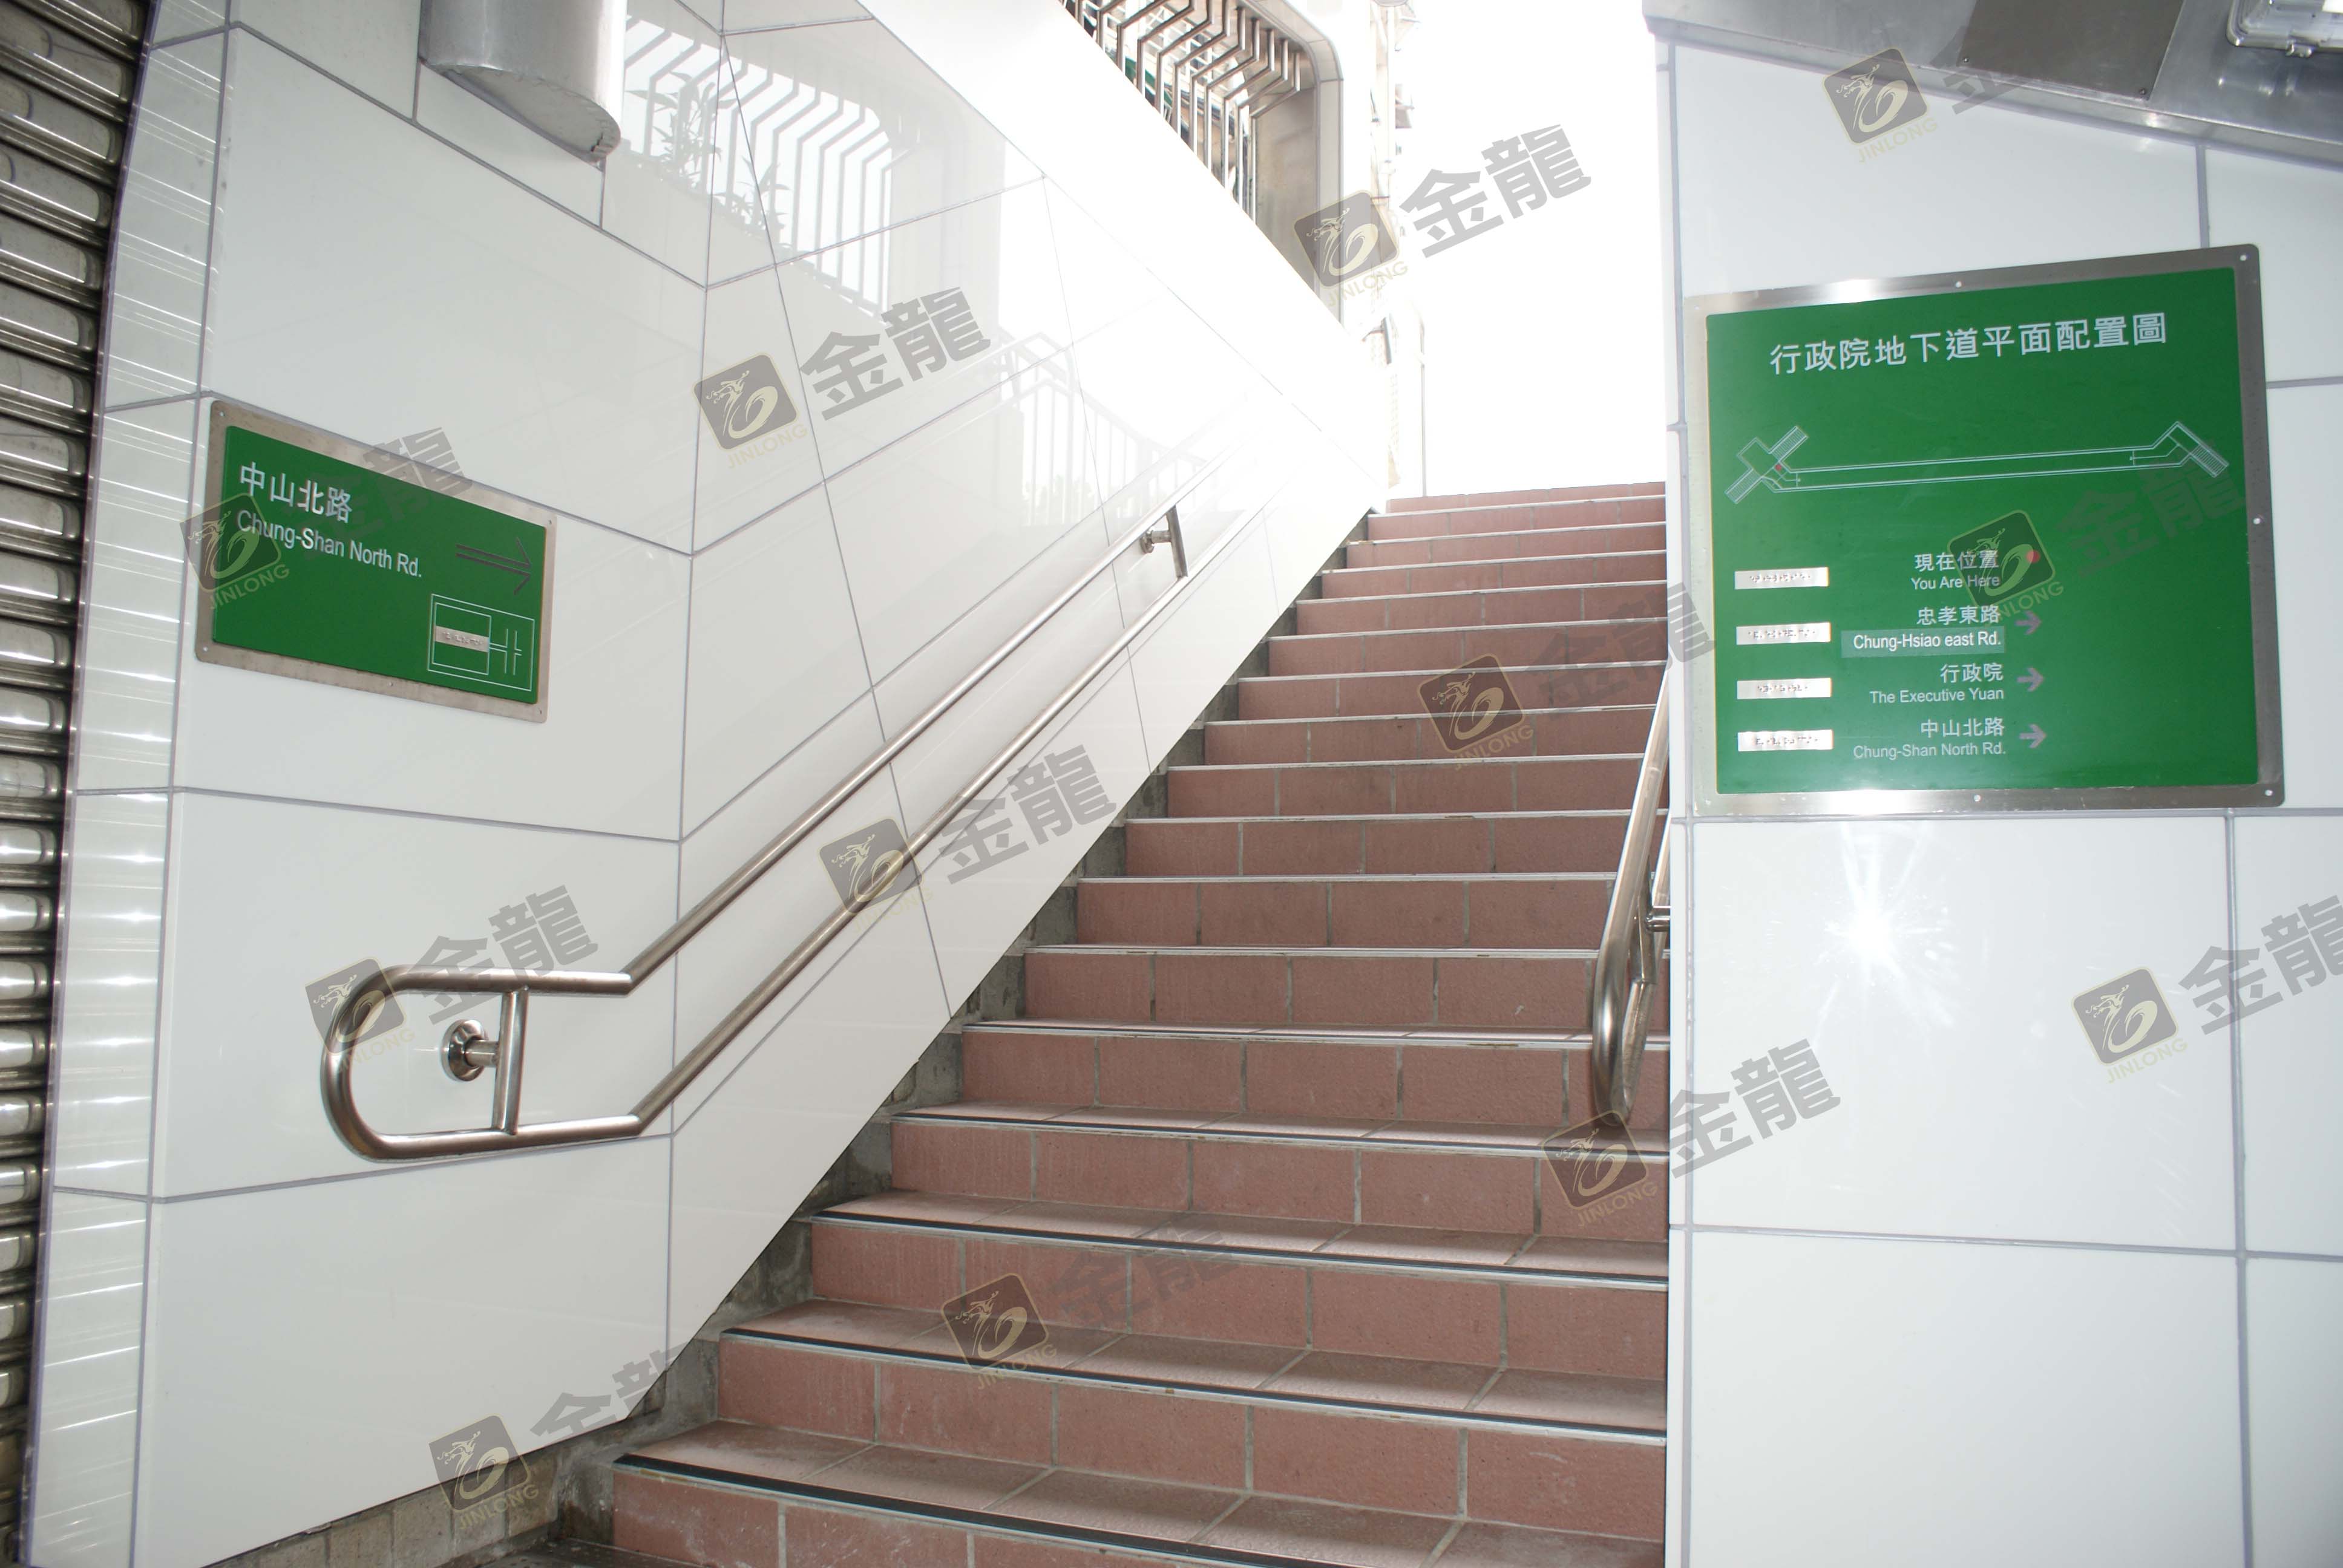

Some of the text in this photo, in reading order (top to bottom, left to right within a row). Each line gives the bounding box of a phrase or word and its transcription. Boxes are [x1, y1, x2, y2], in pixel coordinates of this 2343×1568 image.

[1770, 312, 2167, 375] 行政院地下道平面配置圖
[240, 462, 352, 524] 中山北路
[237, 509, 422, 578] Chung-Shan North Rd.
[1914, 549, 1999, 572] 現在位置
[1911, 575, 2001, 590] You Are Here
[1916, 604, 2001, 626] 忠孝東路
[1853, 630, 2002, 652] Chung-Hsiao east Rd.
[1940, 663, 2004, 684] 行政院
[1869, 687, 2004, 704] The Executive Yuan
[1920, 717, 2005, 738] 中山北路
[1853, 741, 2006, 760] Chung-Shan North Rd.
